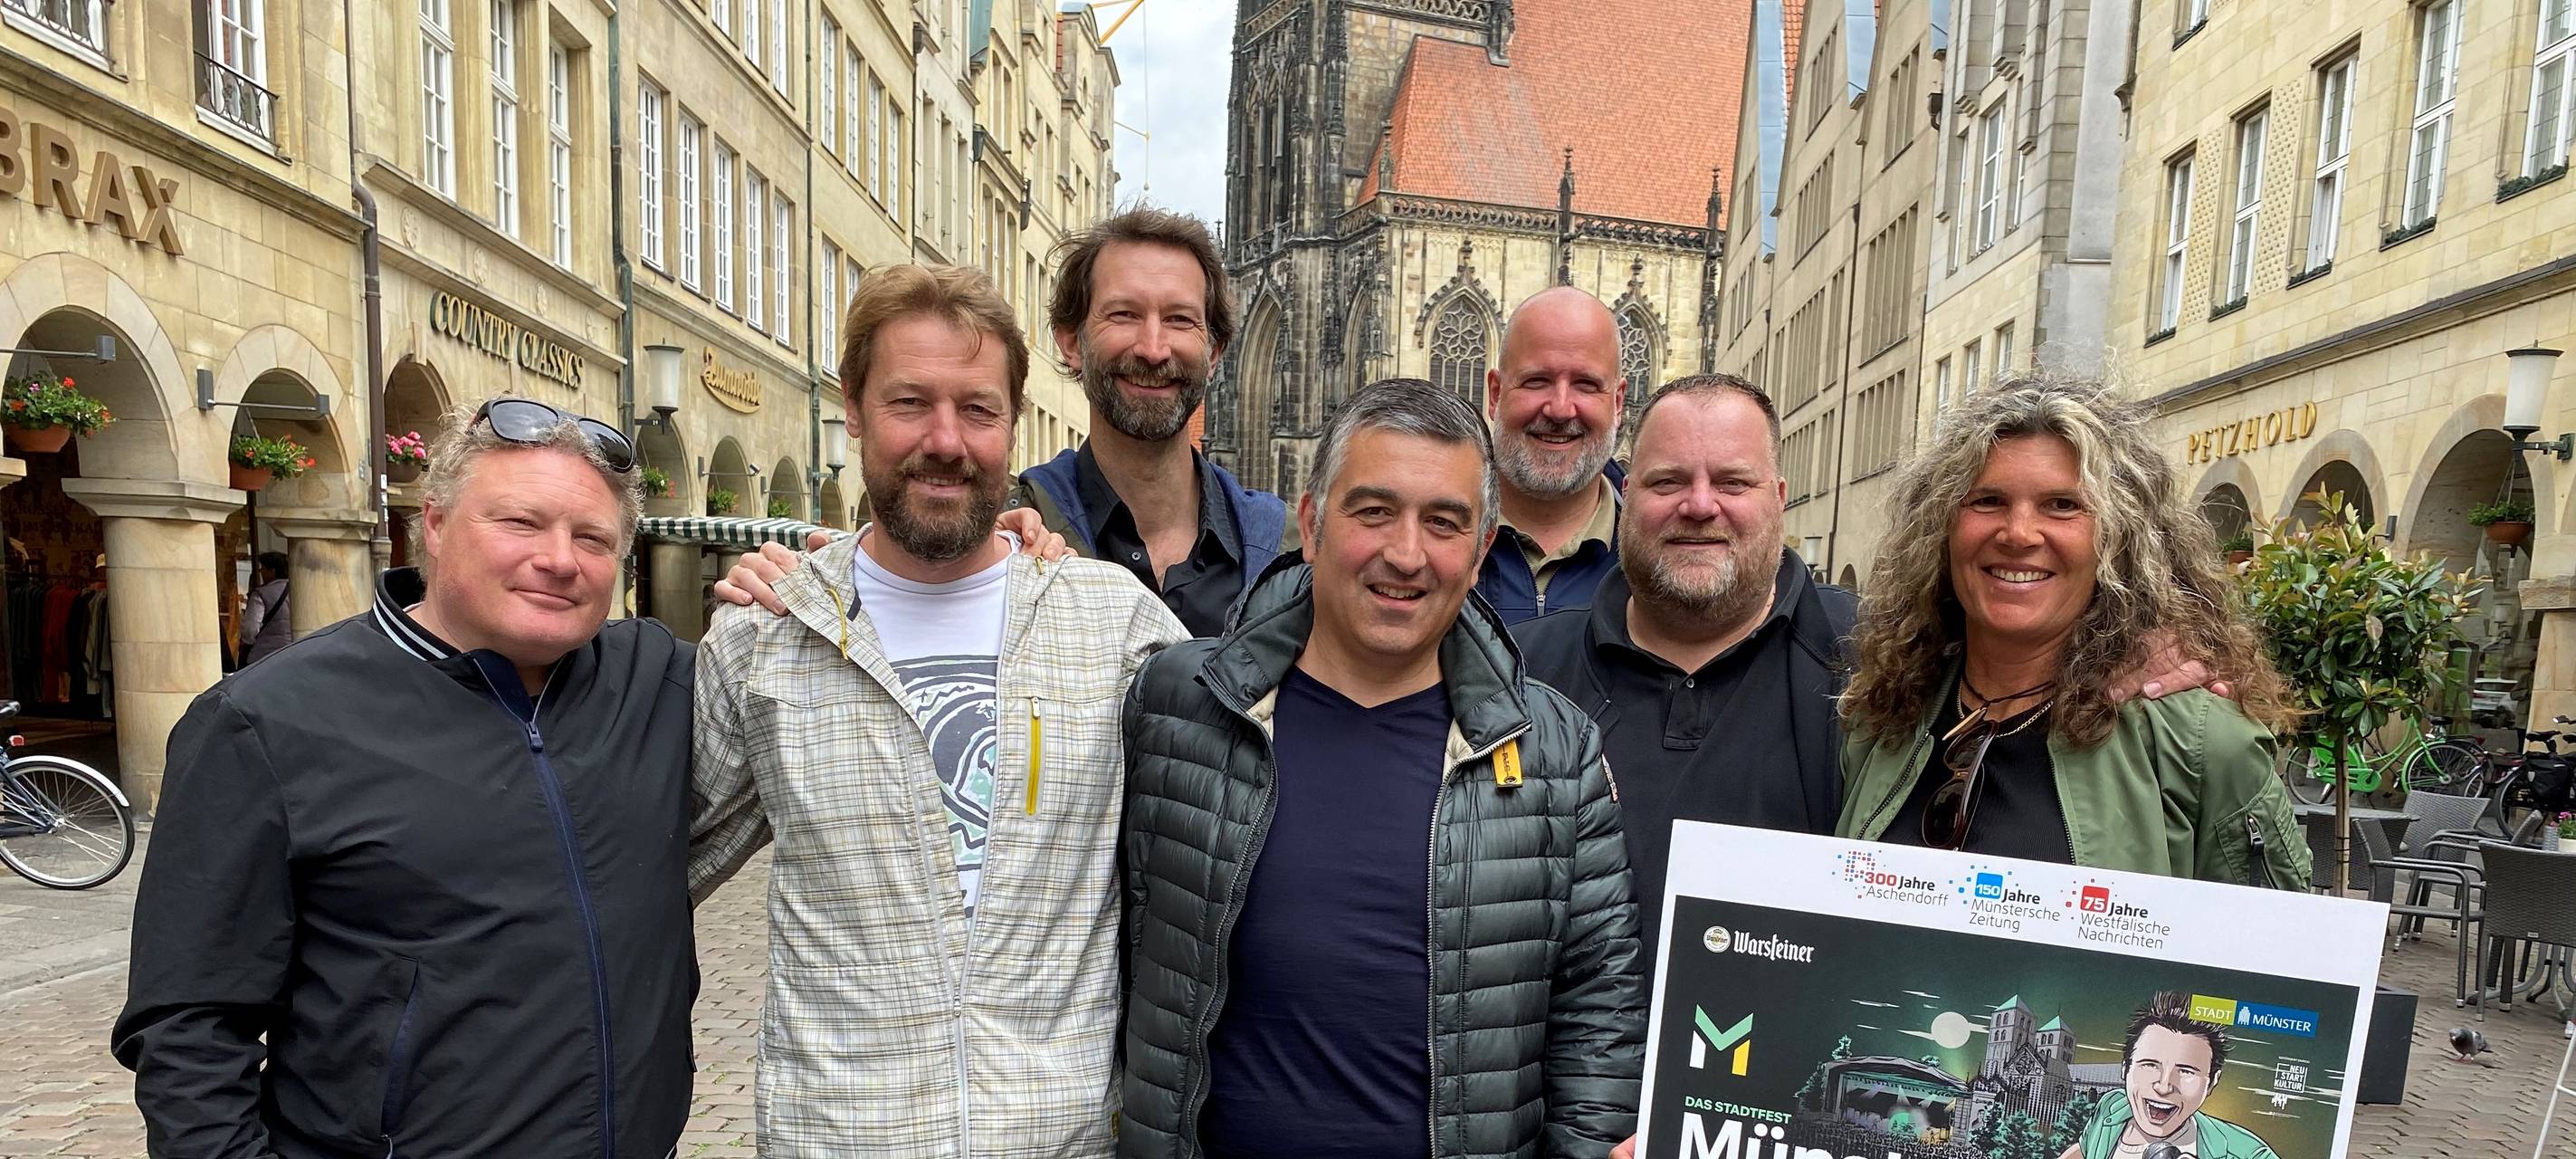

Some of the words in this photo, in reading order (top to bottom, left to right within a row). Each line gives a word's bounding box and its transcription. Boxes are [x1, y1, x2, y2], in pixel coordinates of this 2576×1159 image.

[0, 106, 184, 255] BRAX
[430, 291, 517, 361] COUNTRY
[518, 330, 585, 388] CLASSICS
[2187, 401, 2317, 465] PETZHOLD
[1865, 872, 1897, 886] 300
[1897, 876, 1935, 891] Jahre
[1865, 886, 1949, 906] Aschendorff
[1976, 884, 2000, 896] 150
[2001, 888, 2040, 905] Jahre
[1971, 898, 2060, 921] Münstersche
[2084, 896, 2105, 911] 75
[2108, 902, 2148, 918] Jahre
[1970, 912, 2020, 933] Zeitung
[2081, 913, 2171, 935] Westfälische
[1733, 930, 1815, 963] Warsteiner
[2077, 926, 2163, 950] Nachrichten
[2195, 1006, 2233, 1020] STADT
[2252, 1014, 2311, 1032] MÜNSTER
[2281, 1072, 2304, 1083] START
[2289, 1065, 2305, 1075] NEU
[2274, 1078, 2302, 1091] KULTUR
[1684, 1096, 1713, 1111] DAS
[1714, 1102, 1792, 1125] STADTFEST
